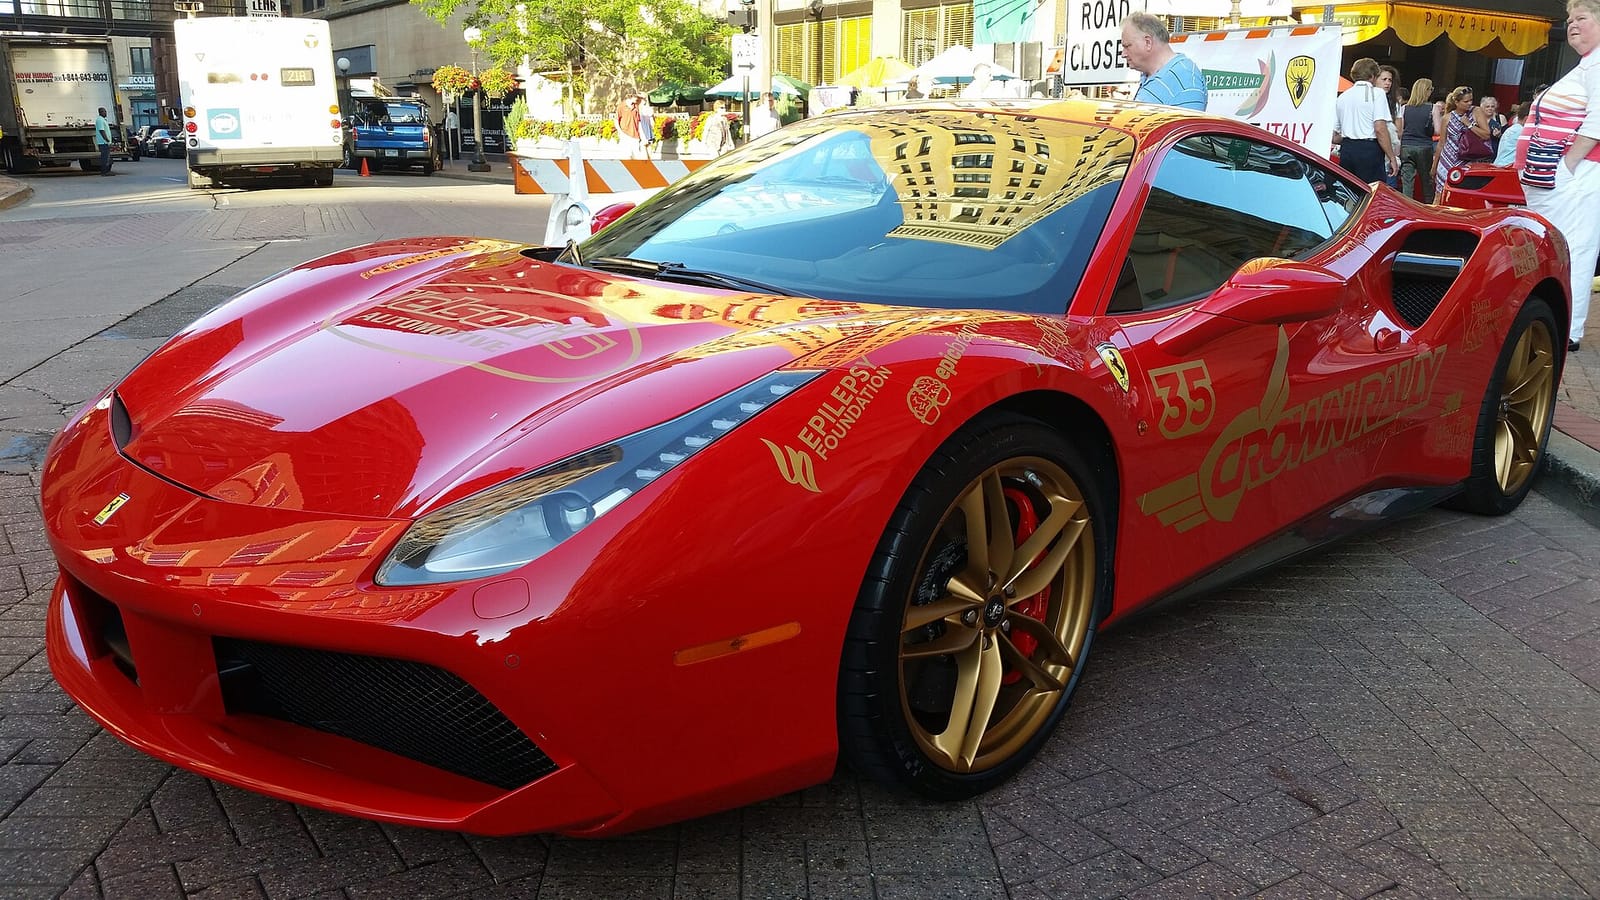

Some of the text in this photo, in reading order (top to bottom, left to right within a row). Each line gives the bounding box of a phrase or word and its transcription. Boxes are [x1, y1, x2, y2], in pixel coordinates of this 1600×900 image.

[1081, 0, 1129, 30] ROAD
[1424, 11, 1517, 34] PAZZALUNA
[1071, 40, 1129, 71] CLOSE
[129, 76, 155, 84] ECOLA
[1205, 74, 1260, 87] PAZZALUNA
[361, 311, 511, 352] AUTOMOTIVE
[797, 354, 877, 450] EPILEPSY
[815, 365, 893, 461] FOUNDATION
[1151, 361, 1214, 437] 35
